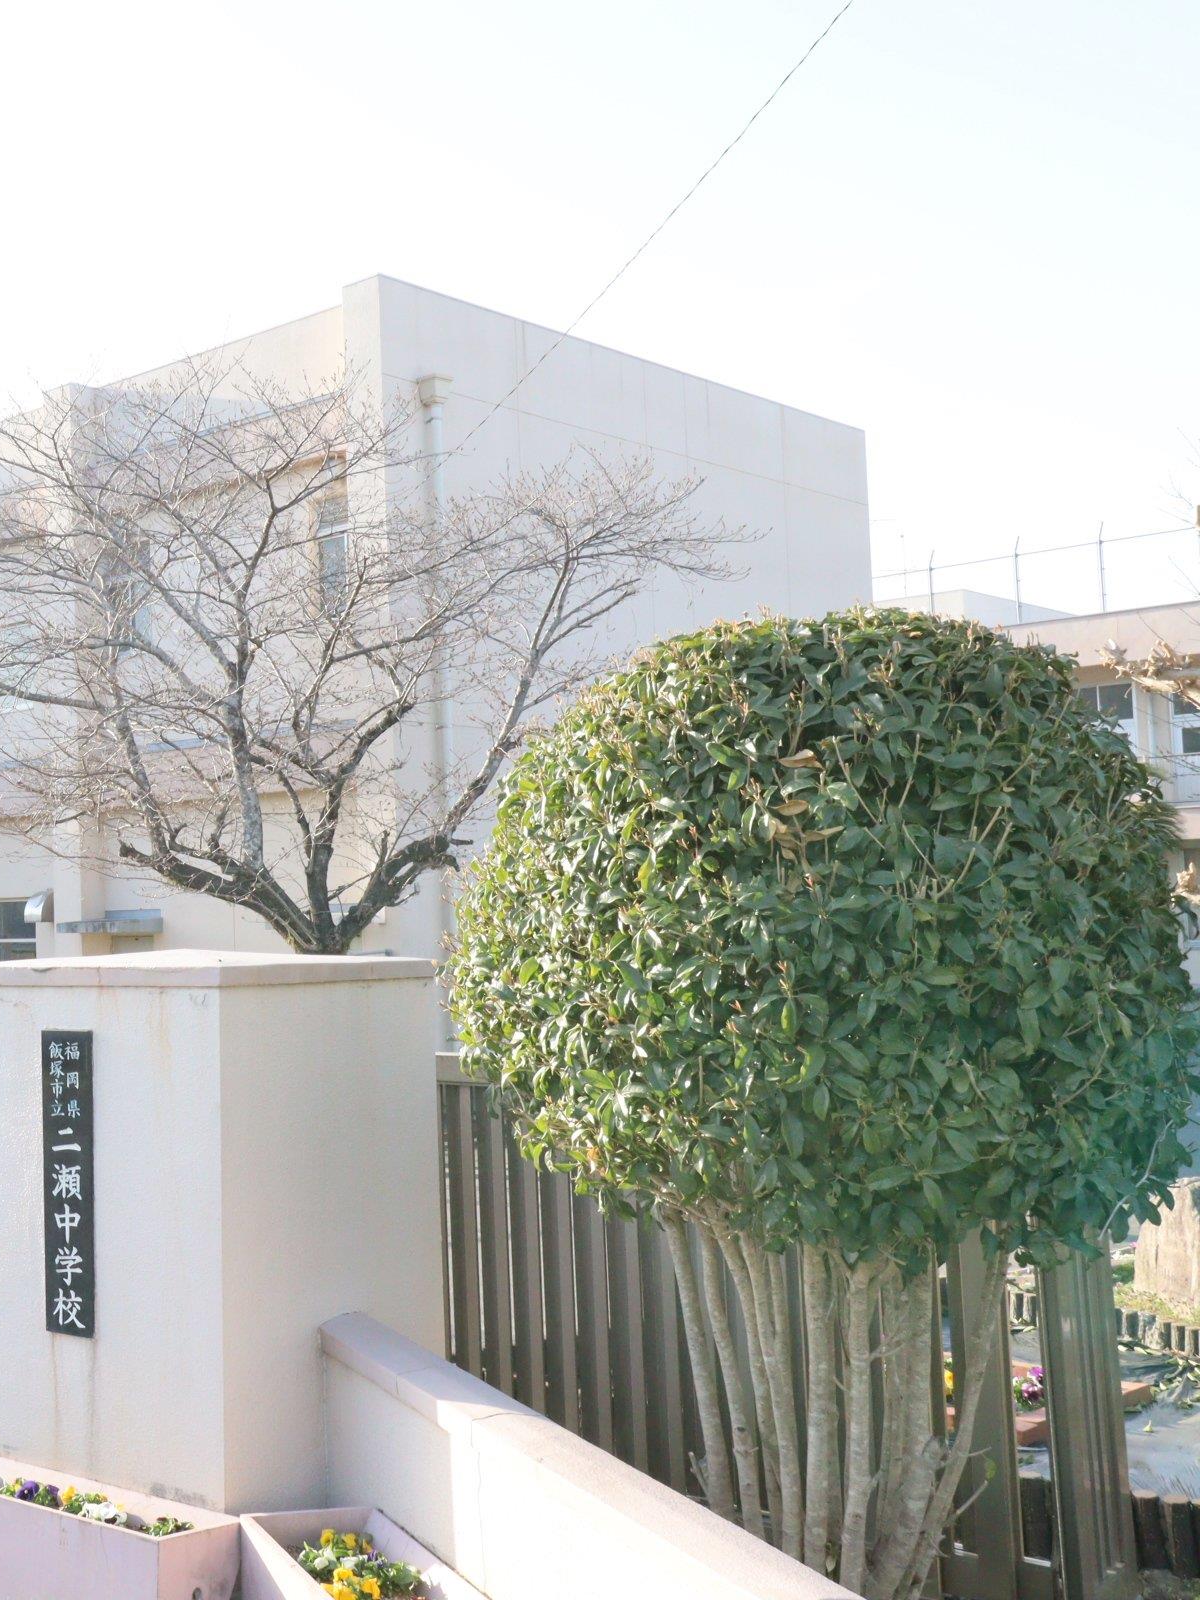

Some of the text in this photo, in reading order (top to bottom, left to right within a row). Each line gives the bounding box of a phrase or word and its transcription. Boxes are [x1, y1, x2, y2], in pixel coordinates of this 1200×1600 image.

[48, 1041, 65, 1117] 飯塚市立
[64, 1041, 81, 1119] 福岡県
[51, 1127, 86, 1329] 二瀬中学校
